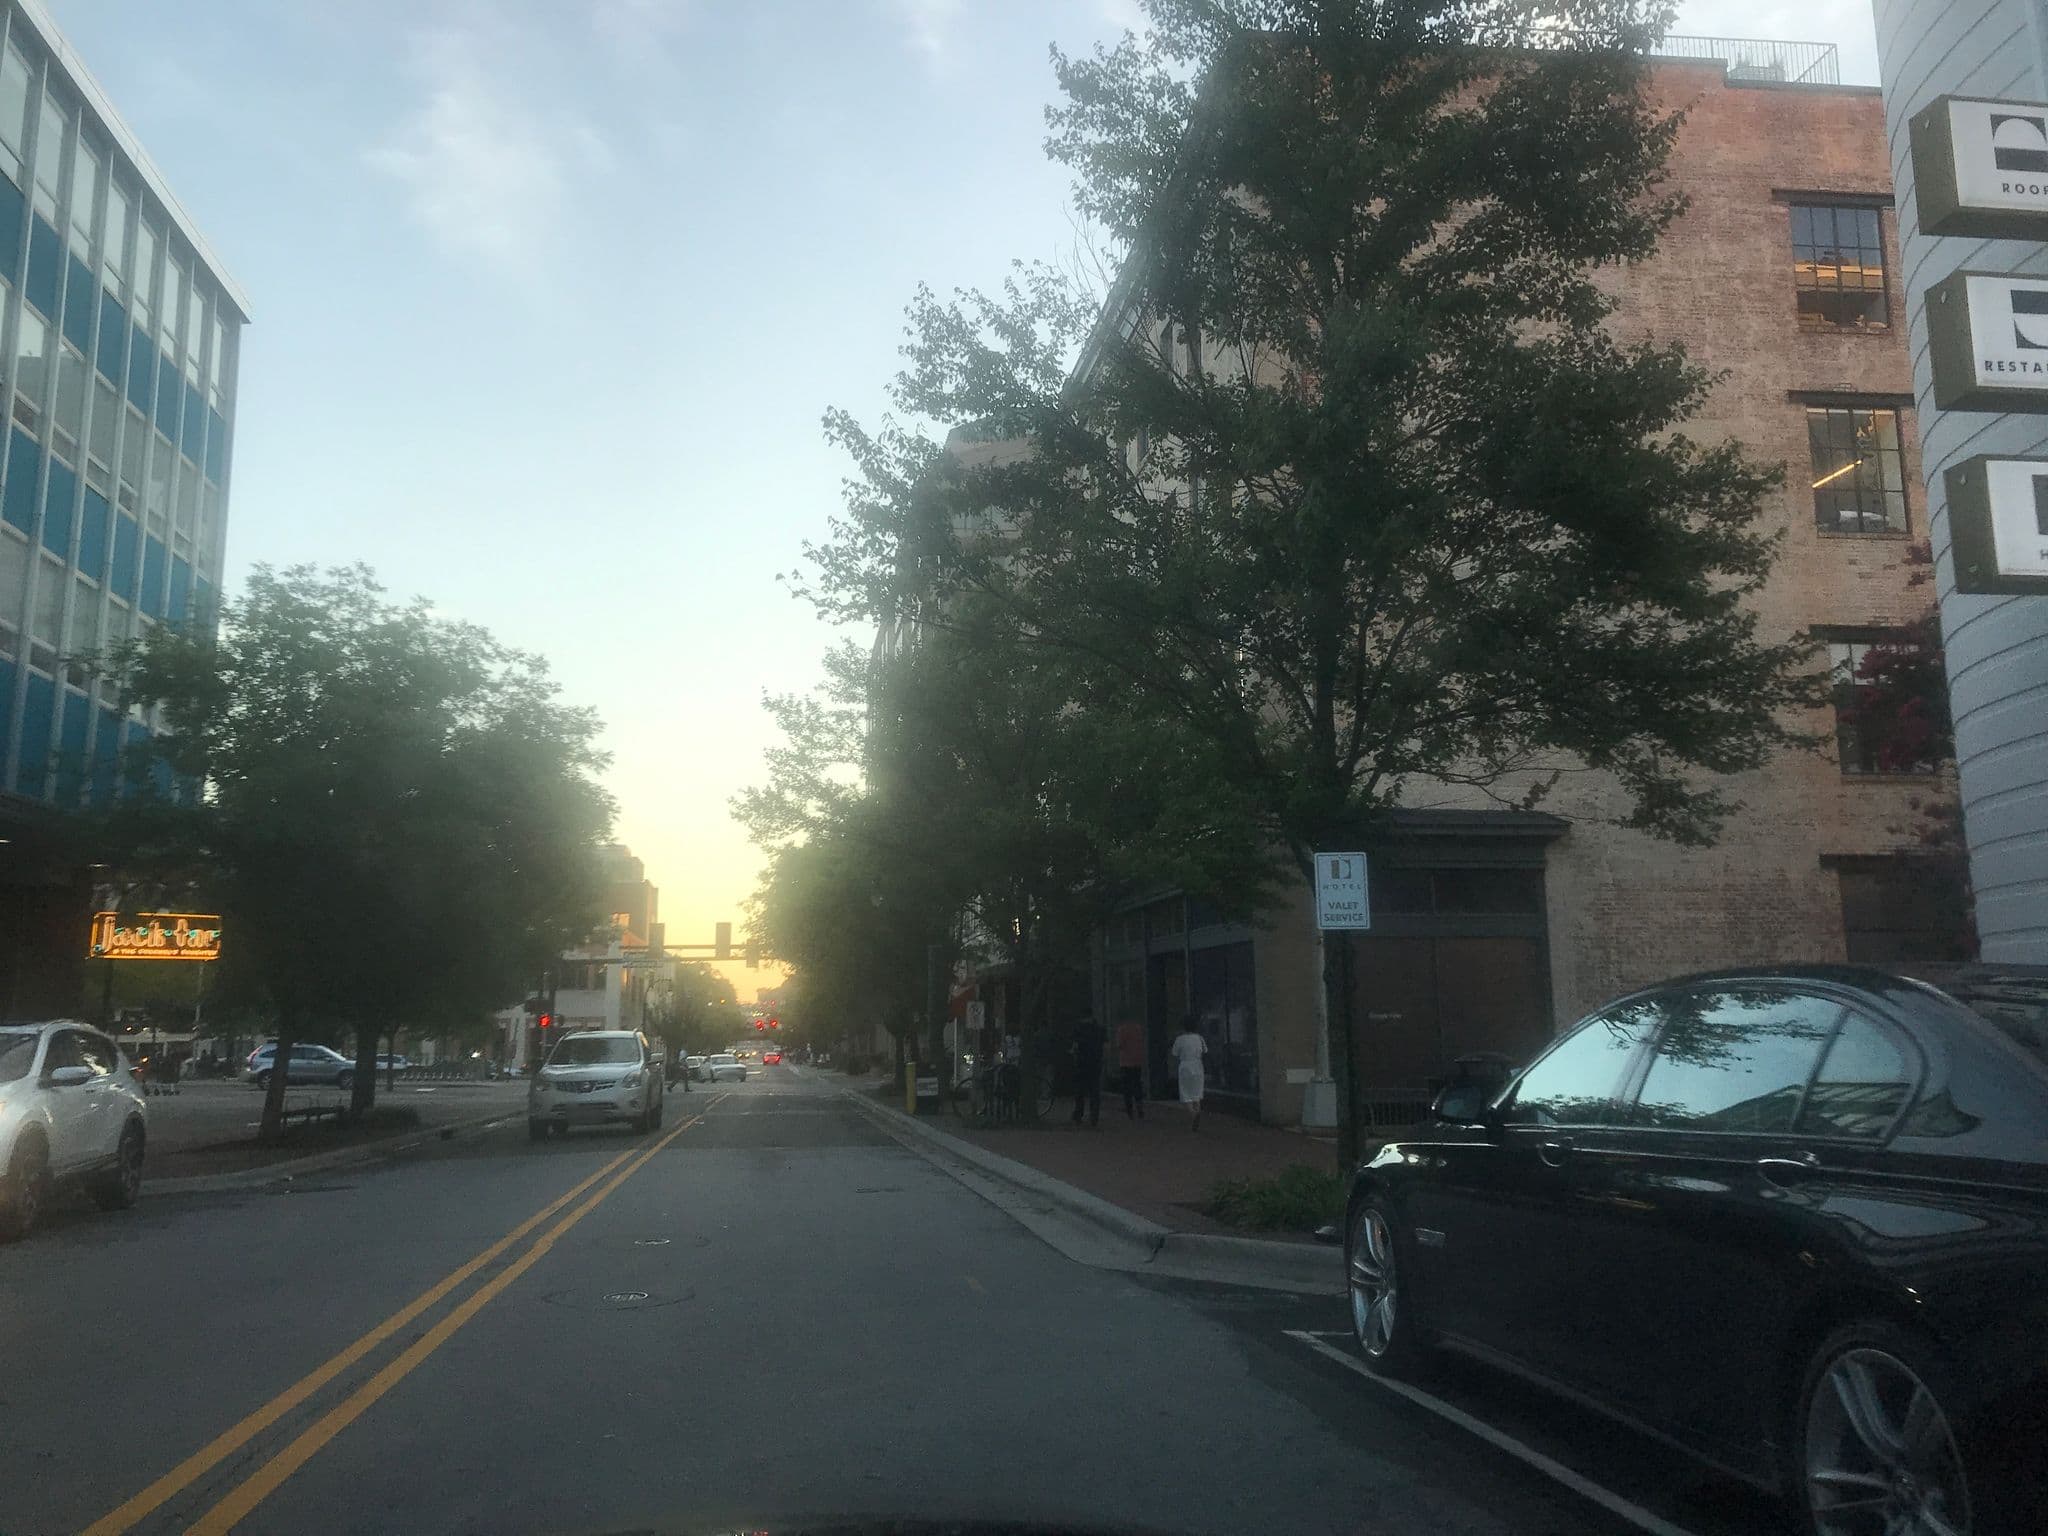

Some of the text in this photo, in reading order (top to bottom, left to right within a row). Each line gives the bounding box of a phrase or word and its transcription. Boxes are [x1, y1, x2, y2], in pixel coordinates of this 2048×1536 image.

[1985, 360, 2048, 373] RESTA
[1328, 901, 1359, 910] VALET
[1324, 913, 1364, 922] SERVICE
